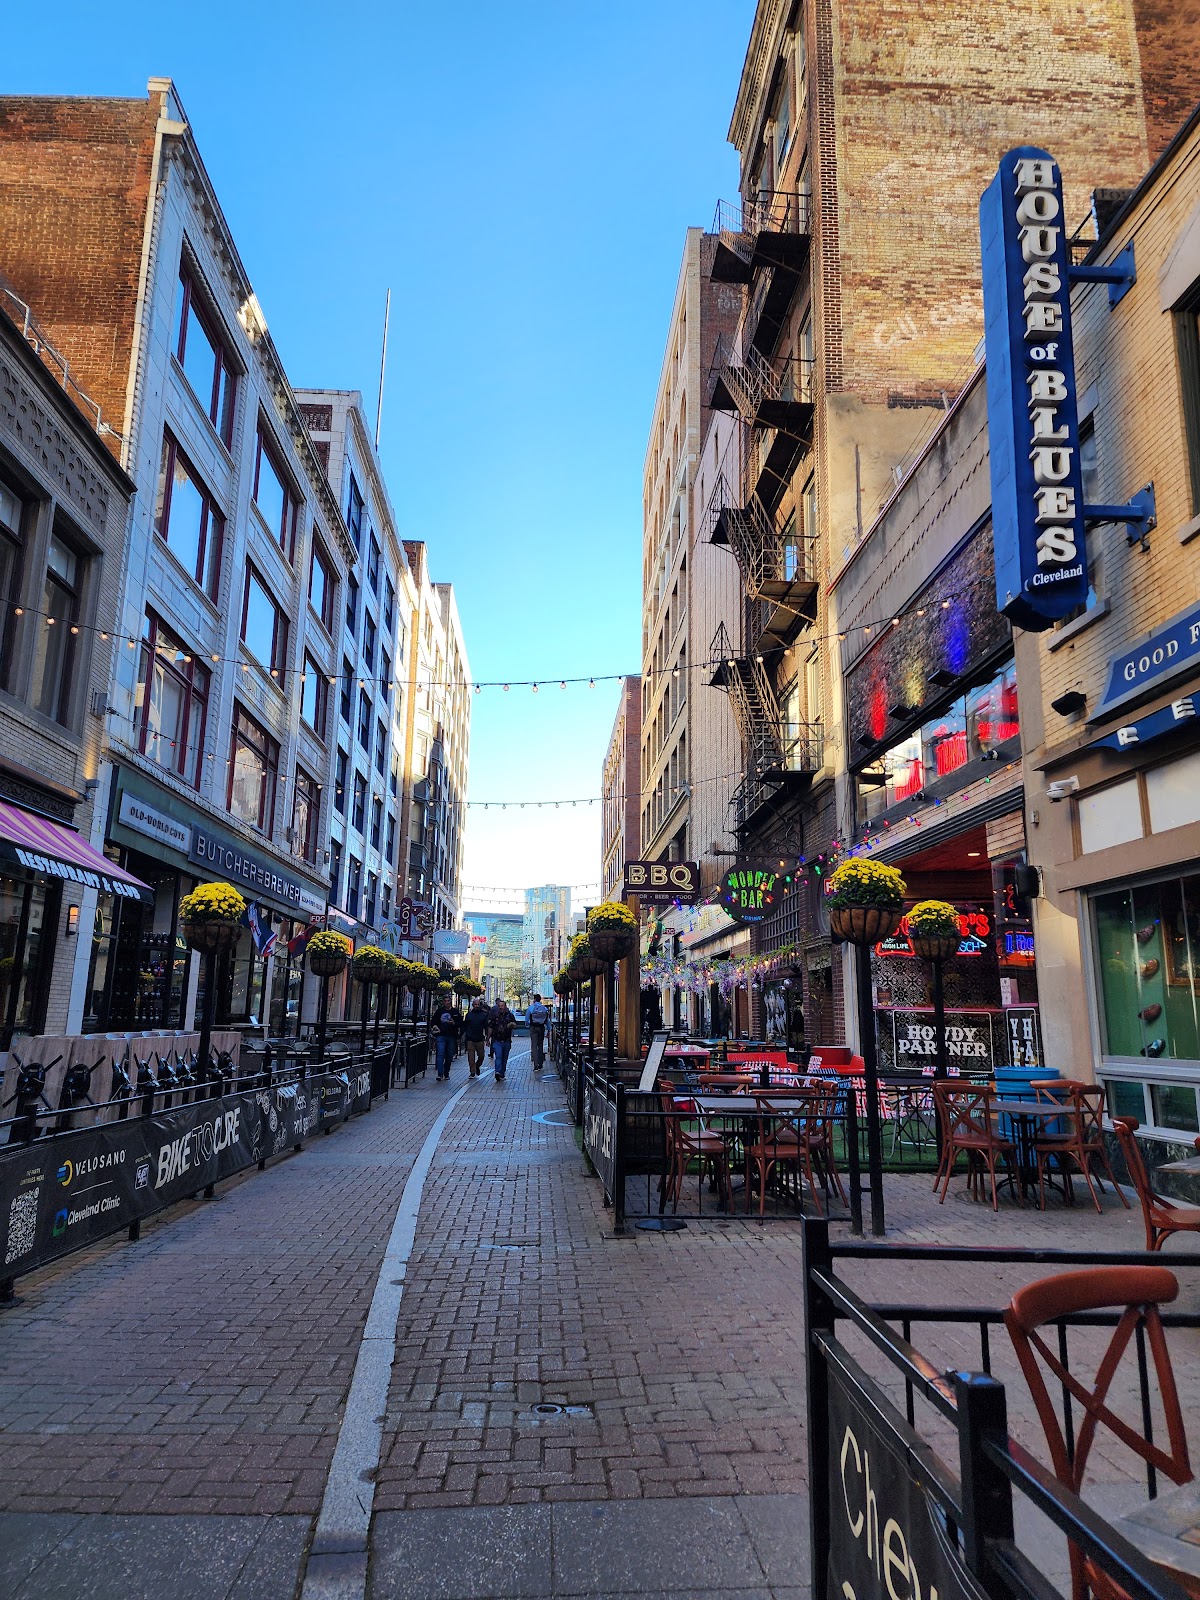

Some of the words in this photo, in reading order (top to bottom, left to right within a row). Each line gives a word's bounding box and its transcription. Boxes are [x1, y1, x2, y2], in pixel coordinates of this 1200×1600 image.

[1013, 158, 1063, 341] HOUSE
[1029, 342, 1058, 361] of
[1027, 369, 1078, 567] BLUES
[1032, 565, 1083, 586] Cleveland
[1124, 639, 1179, 681] GOOD
[130, 806, 170, 834] OLD-WORLD
[169, 827, 185, 842] CUTS
[14, 847, 101, 889] RESTAURANT
[112, 880, 141, 900] CLUB
[196, 834, 257, 882] BUTCHER
[264, 870, 300, 903] BREWER
[628, 864, 694, 891] BBQ
[728, 871, 776, 892] WONDER
[741, 889, 764, 909] BAR
[401, 902, 411, 935] CLOY
[899, 1040, 988, 1056] PARNER
[76, 1149, 126, 1176] VELOSANO
[154, 1132, 191, 1189] BIKE
[212, 1108, 240, 1155] CURE
[67, 1201, 100, 1225] Cleveland
[100, 1195, 121, 1213] Clinic
